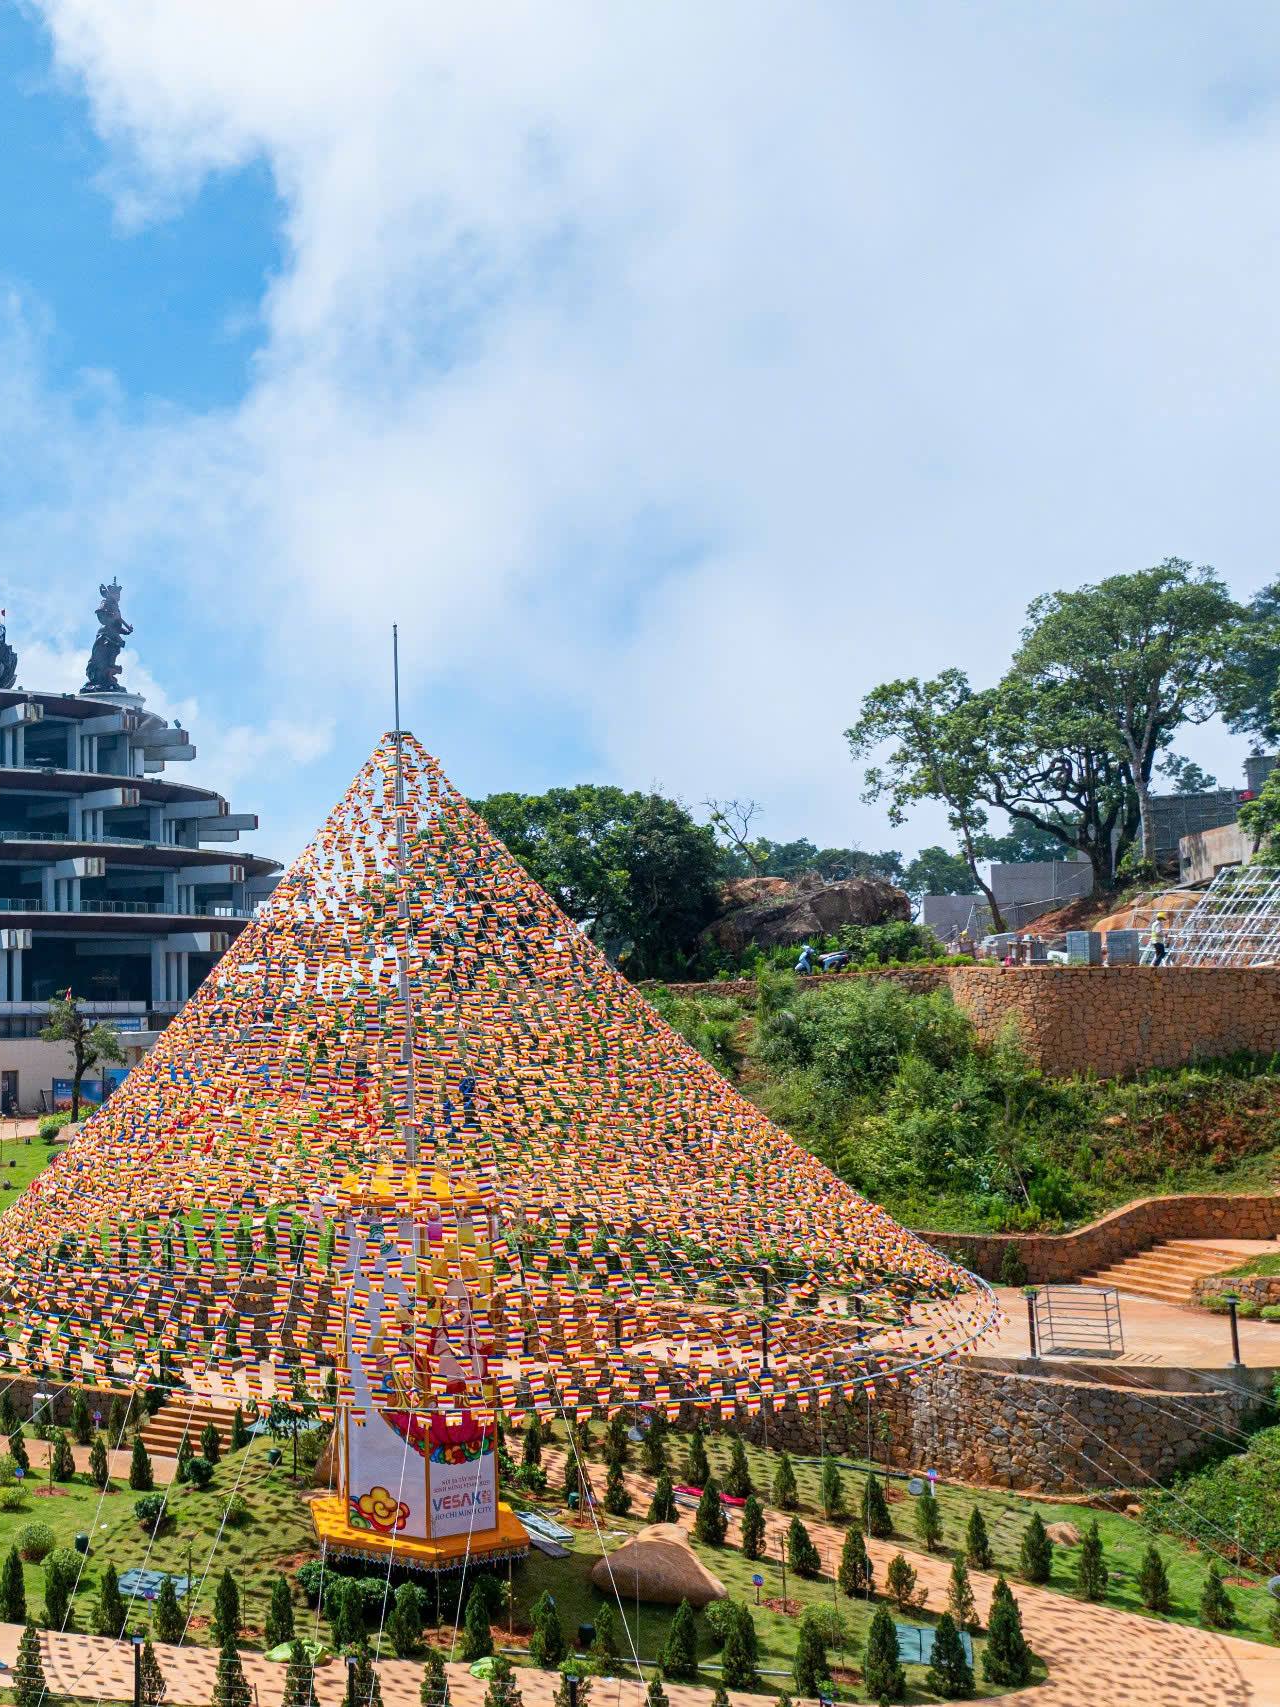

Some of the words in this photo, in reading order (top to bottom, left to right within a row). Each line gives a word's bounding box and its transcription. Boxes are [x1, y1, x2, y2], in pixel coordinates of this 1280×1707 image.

[432, 1491, 481, 1512] VESAK
[459, 1508, 477, 1517] MINH
[478, 1505, 492, 1514] CITY
